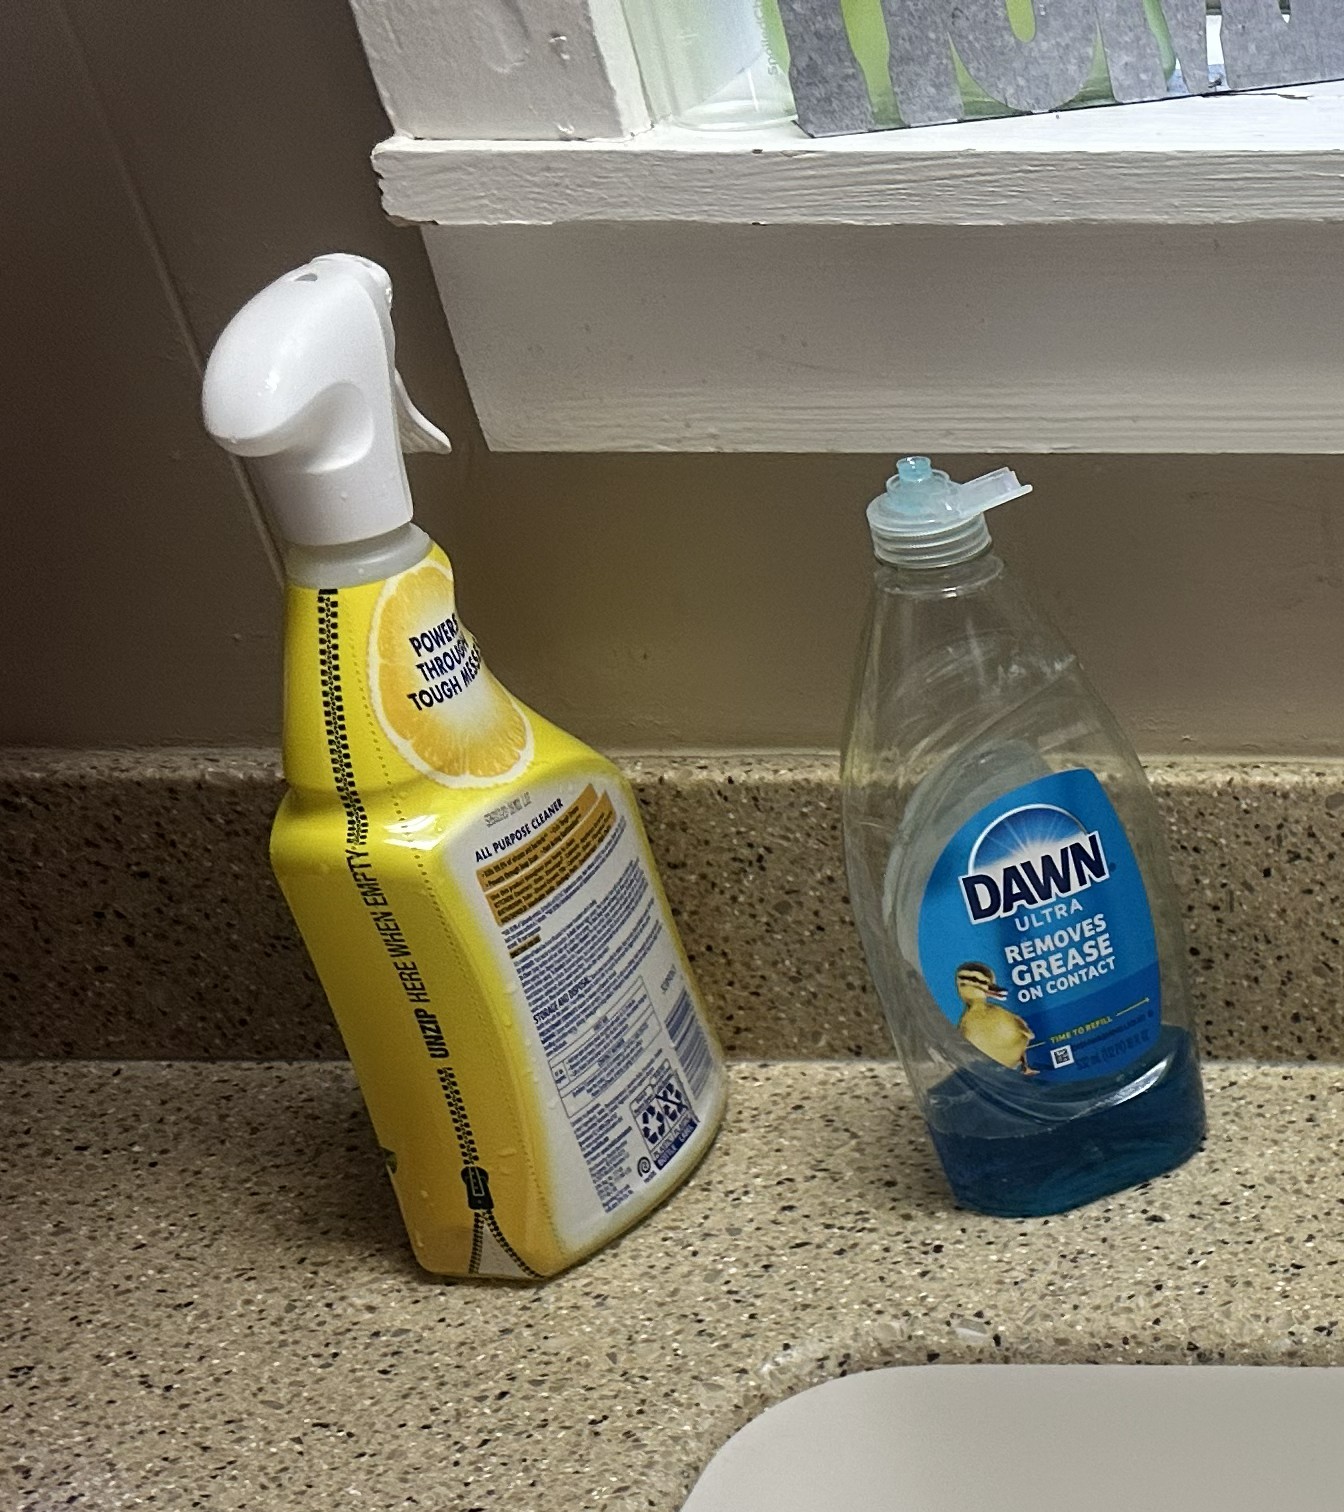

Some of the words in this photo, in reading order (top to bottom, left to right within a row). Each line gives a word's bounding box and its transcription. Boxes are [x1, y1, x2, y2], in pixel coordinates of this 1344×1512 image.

[409, 612, 459, 657] POWERS
[406, 676, 463, 711] TOUGH
[475, 846, 493, 863] ALL
[492, 823, 532, 854] PURPOSE
[531, 797, 564, 830] CLEANER
[345, 848, 388, 907] EMPTY
[961, 833, 1107, 922] DAWN
[370, 911, 412, 958] WHEN
[1004, 913, 1107, 965] REMOVES
[1015, 898, 1083, 932] ULTRA
[393, 960, 431, 1003] HERE
[1011, 933, 1114, 987] GREASE
[1017, 985, 1044, 1003] ON
[1045, 955, 1116, 994] CONTACT
[413, 1007, 450, 1060] UNZIP
[1050, 1031, 1072, 1044] TIME
[1073, 1026, 1086, 1037] TO
[1085, 1015, 1113, 1032] REFILL
